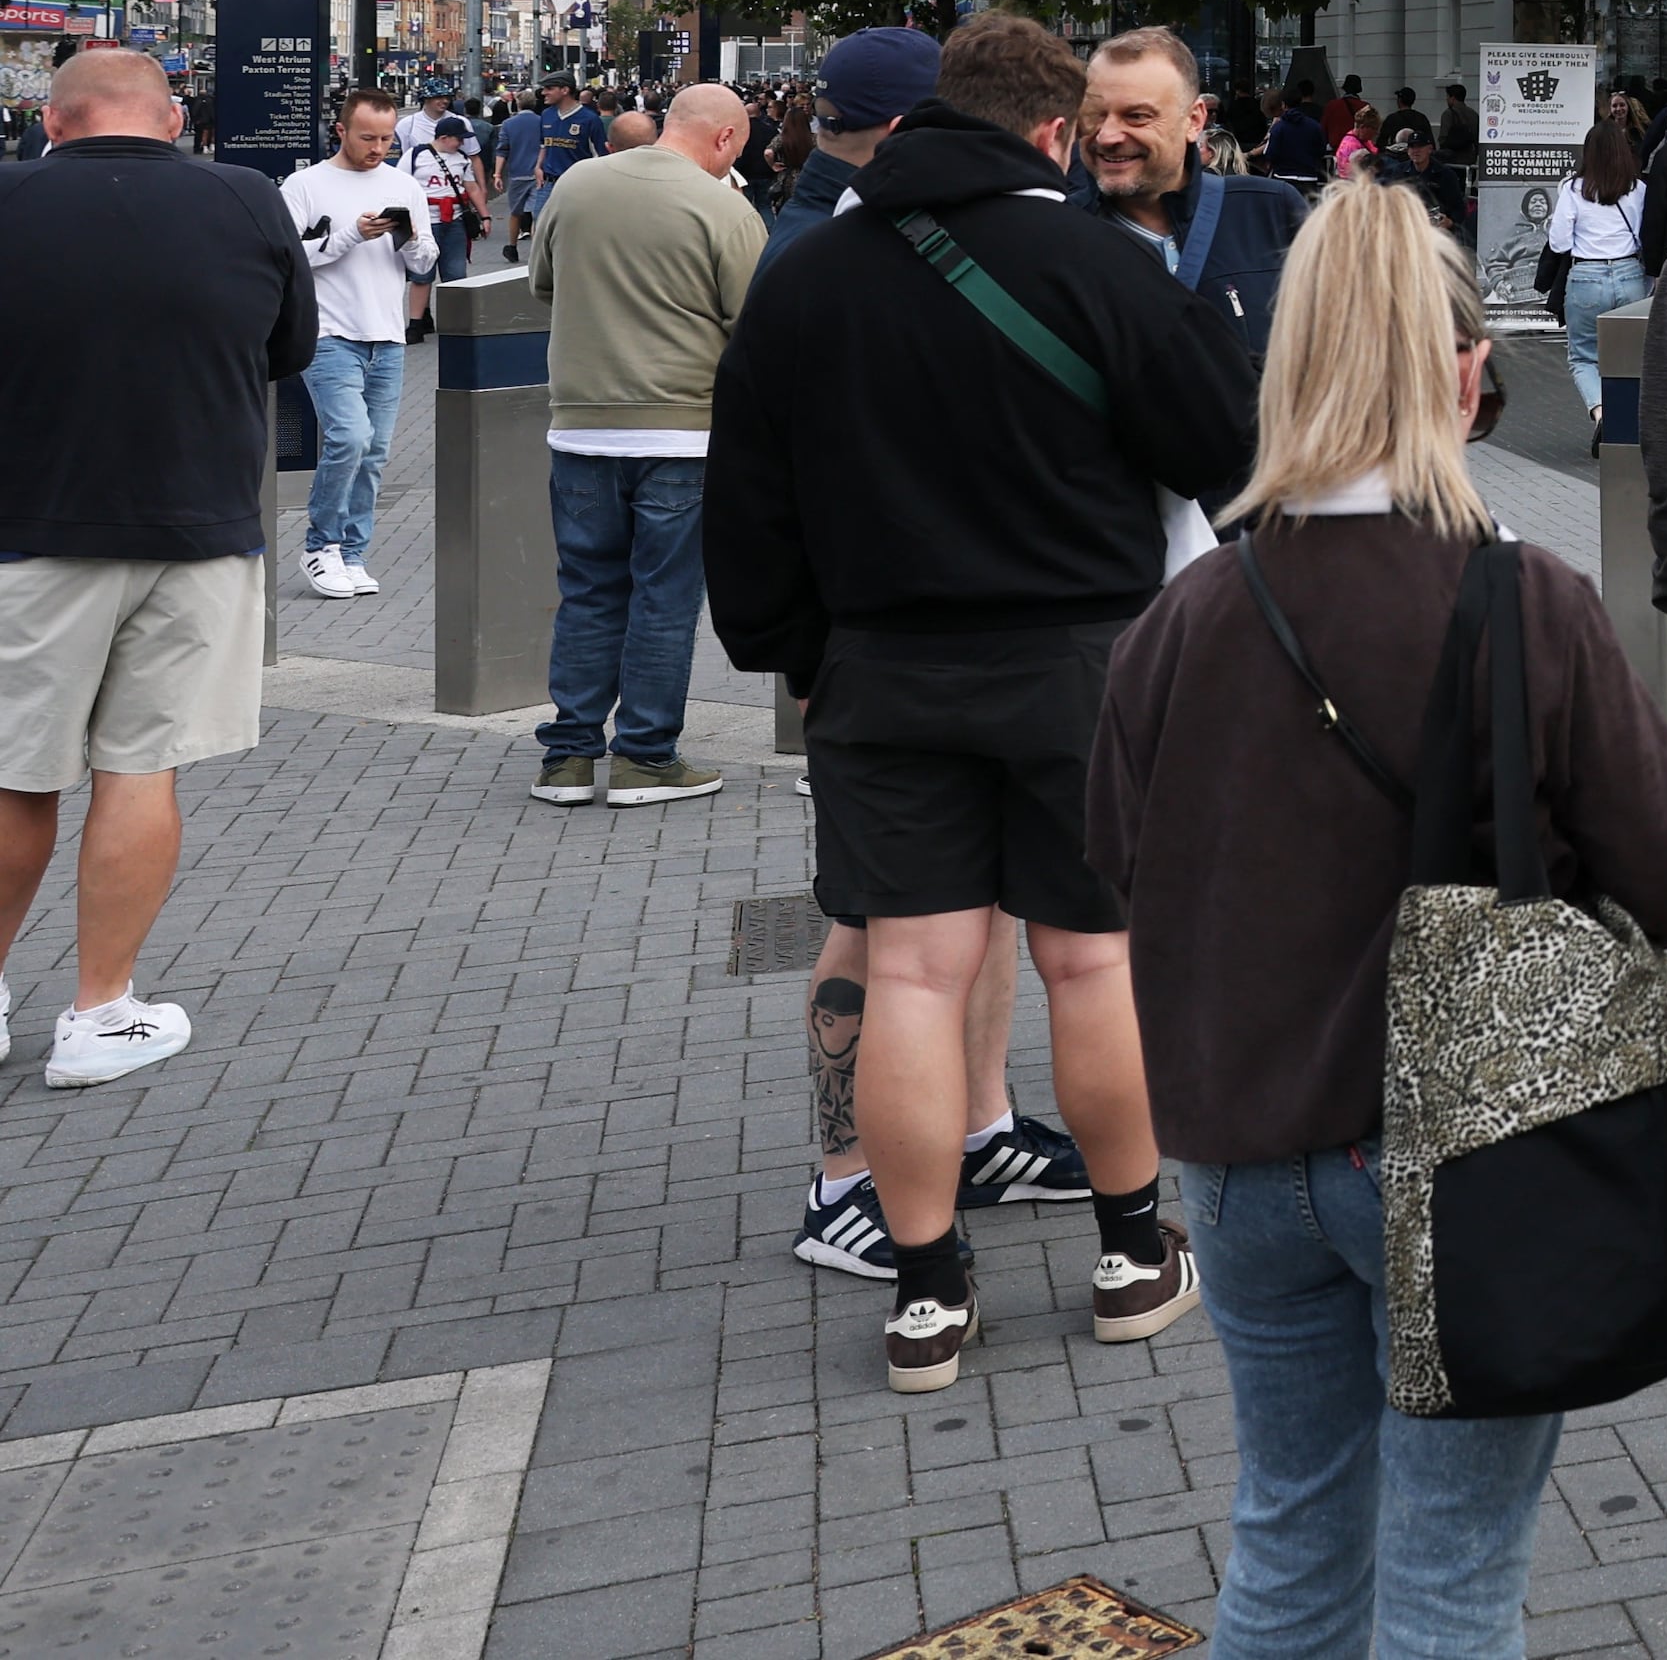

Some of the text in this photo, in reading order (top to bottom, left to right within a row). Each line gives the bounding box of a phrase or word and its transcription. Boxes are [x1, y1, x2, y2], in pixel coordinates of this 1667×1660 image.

[242, 66, 311, 74] Paxton Terrace
[281, 128, 311, 136] Academy
[259, 142, 286, 150] Hotspur
[1486, 149, 1572, 159] HOMELESSNESS:
[1486, 159, 1576, 168] OUR COMMUNITY
[1511, 168, 1560, 176] PROBLEM
[1100, 1275, 1123, 1283] adidas
[909, 1321, 937, 1332] adidas
